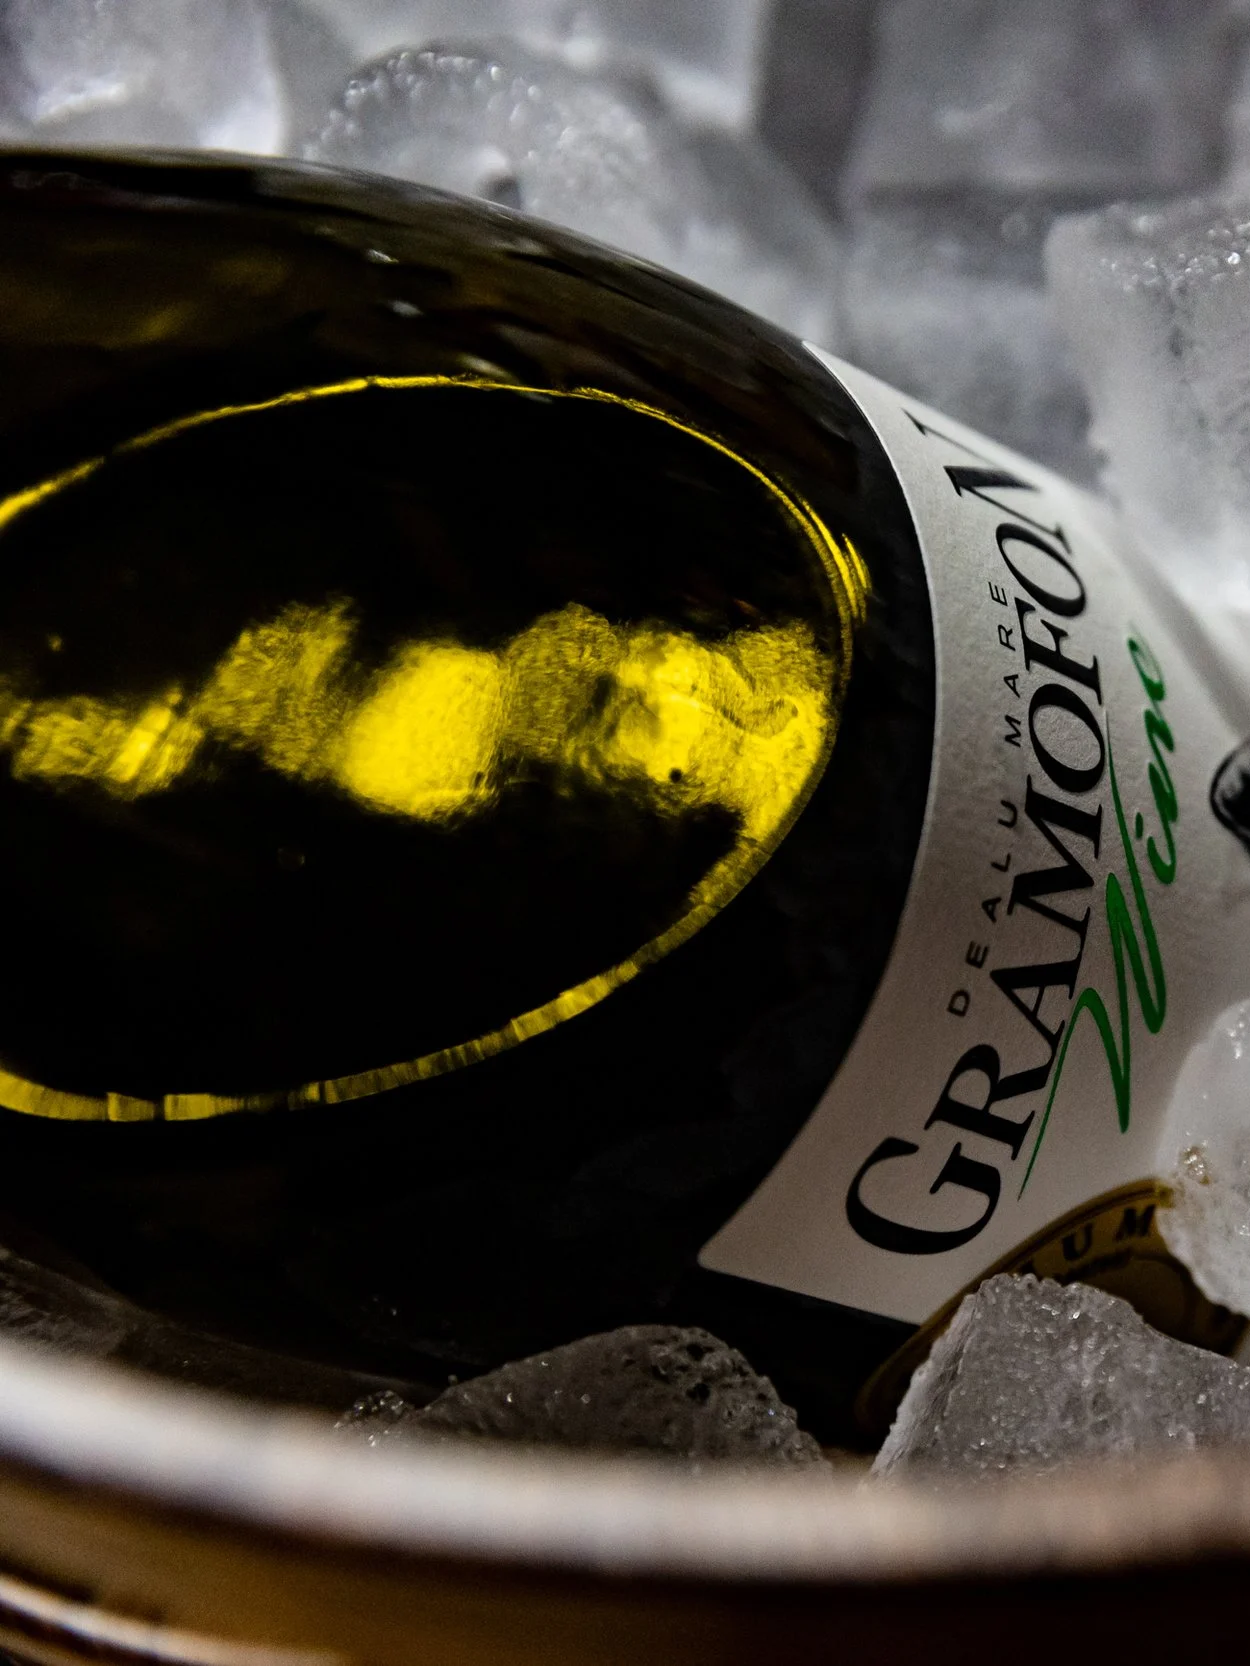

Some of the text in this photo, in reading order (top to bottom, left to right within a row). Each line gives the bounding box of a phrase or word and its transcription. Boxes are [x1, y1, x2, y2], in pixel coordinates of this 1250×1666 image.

[846, 408, 1105, 1255] GRAMOFON
[946, 581, 1022, 1017] DEALU MARE
[1018, 622, 1177, 1201] Wine
